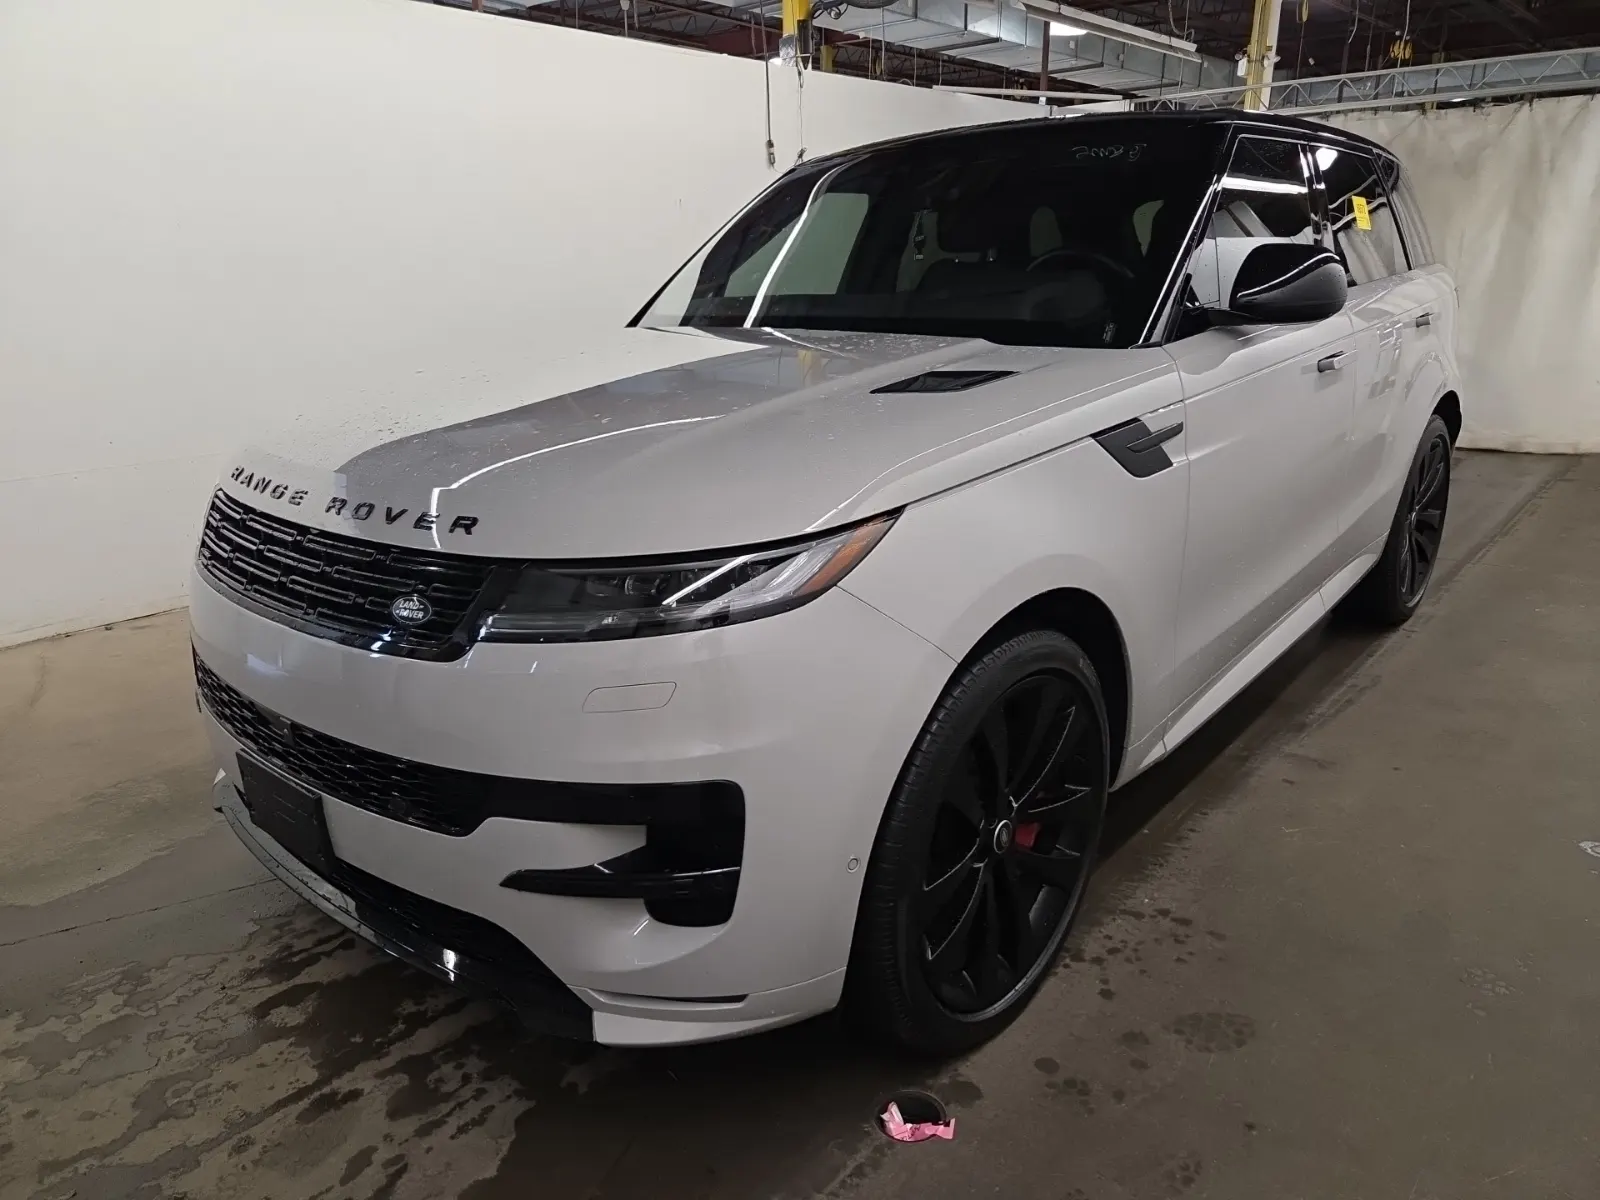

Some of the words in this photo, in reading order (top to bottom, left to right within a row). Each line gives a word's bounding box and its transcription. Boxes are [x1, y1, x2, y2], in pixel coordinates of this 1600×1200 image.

[230, 465, 308, 506] RANGE
[325, 496, 479, 535] ROVER
[399, 600, 419, 610] LAND
[399, 609, 424, 619] ROVER
